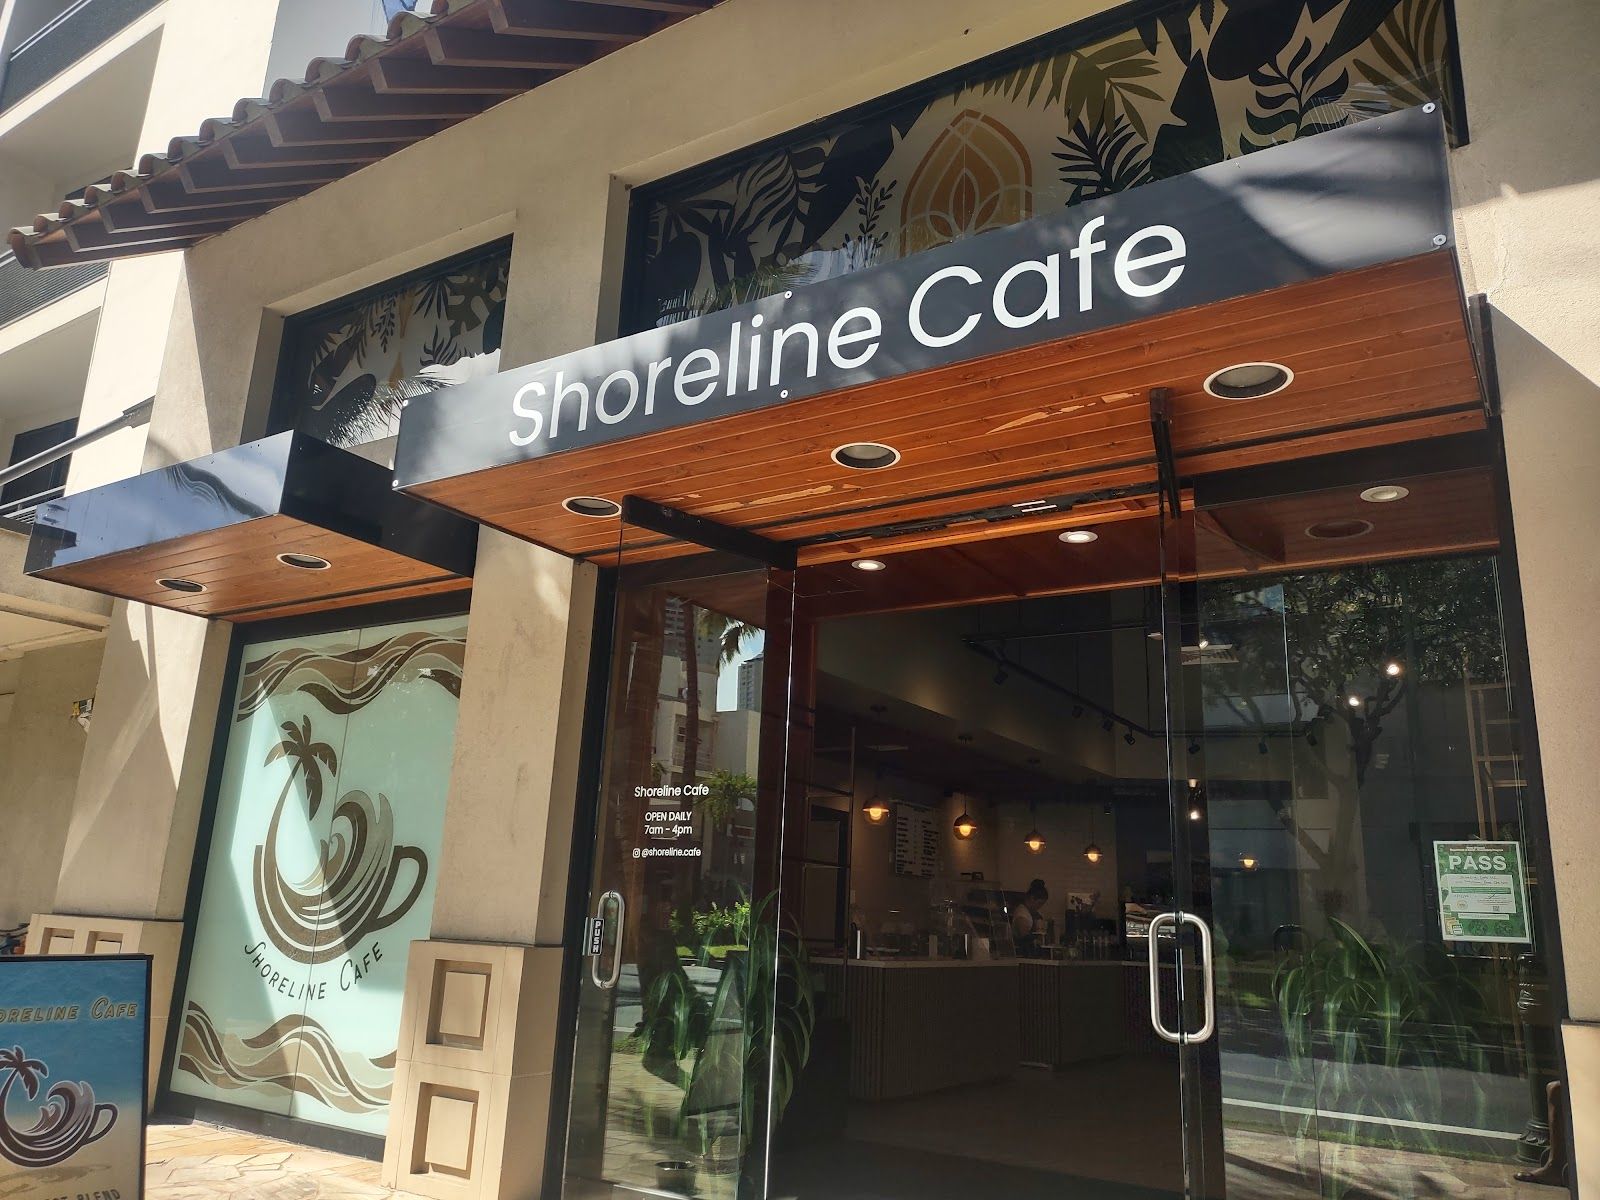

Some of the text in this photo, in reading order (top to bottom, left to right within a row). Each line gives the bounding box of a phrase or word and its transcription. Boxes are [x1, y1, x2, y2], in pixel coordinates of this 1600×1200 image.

[508, 214, 1188, 448] Shoreline Cafe
[634, 784, 709, 797] Shoreline Cafe
[645, 811, 692, 821] OPEN DAILY
[644, 825, 664, 834] 7am
[672, 824, 693, 837] 4pm
[641, 847, 701, 857] @shoreline.cafe
[1448, 855, 1507, 871] PASS
[592, 920, 601, 952] PUSH
[244, 941, 383, 1001] SHORELINE CAFE
[91, 996, 138, 1019] CAFE
